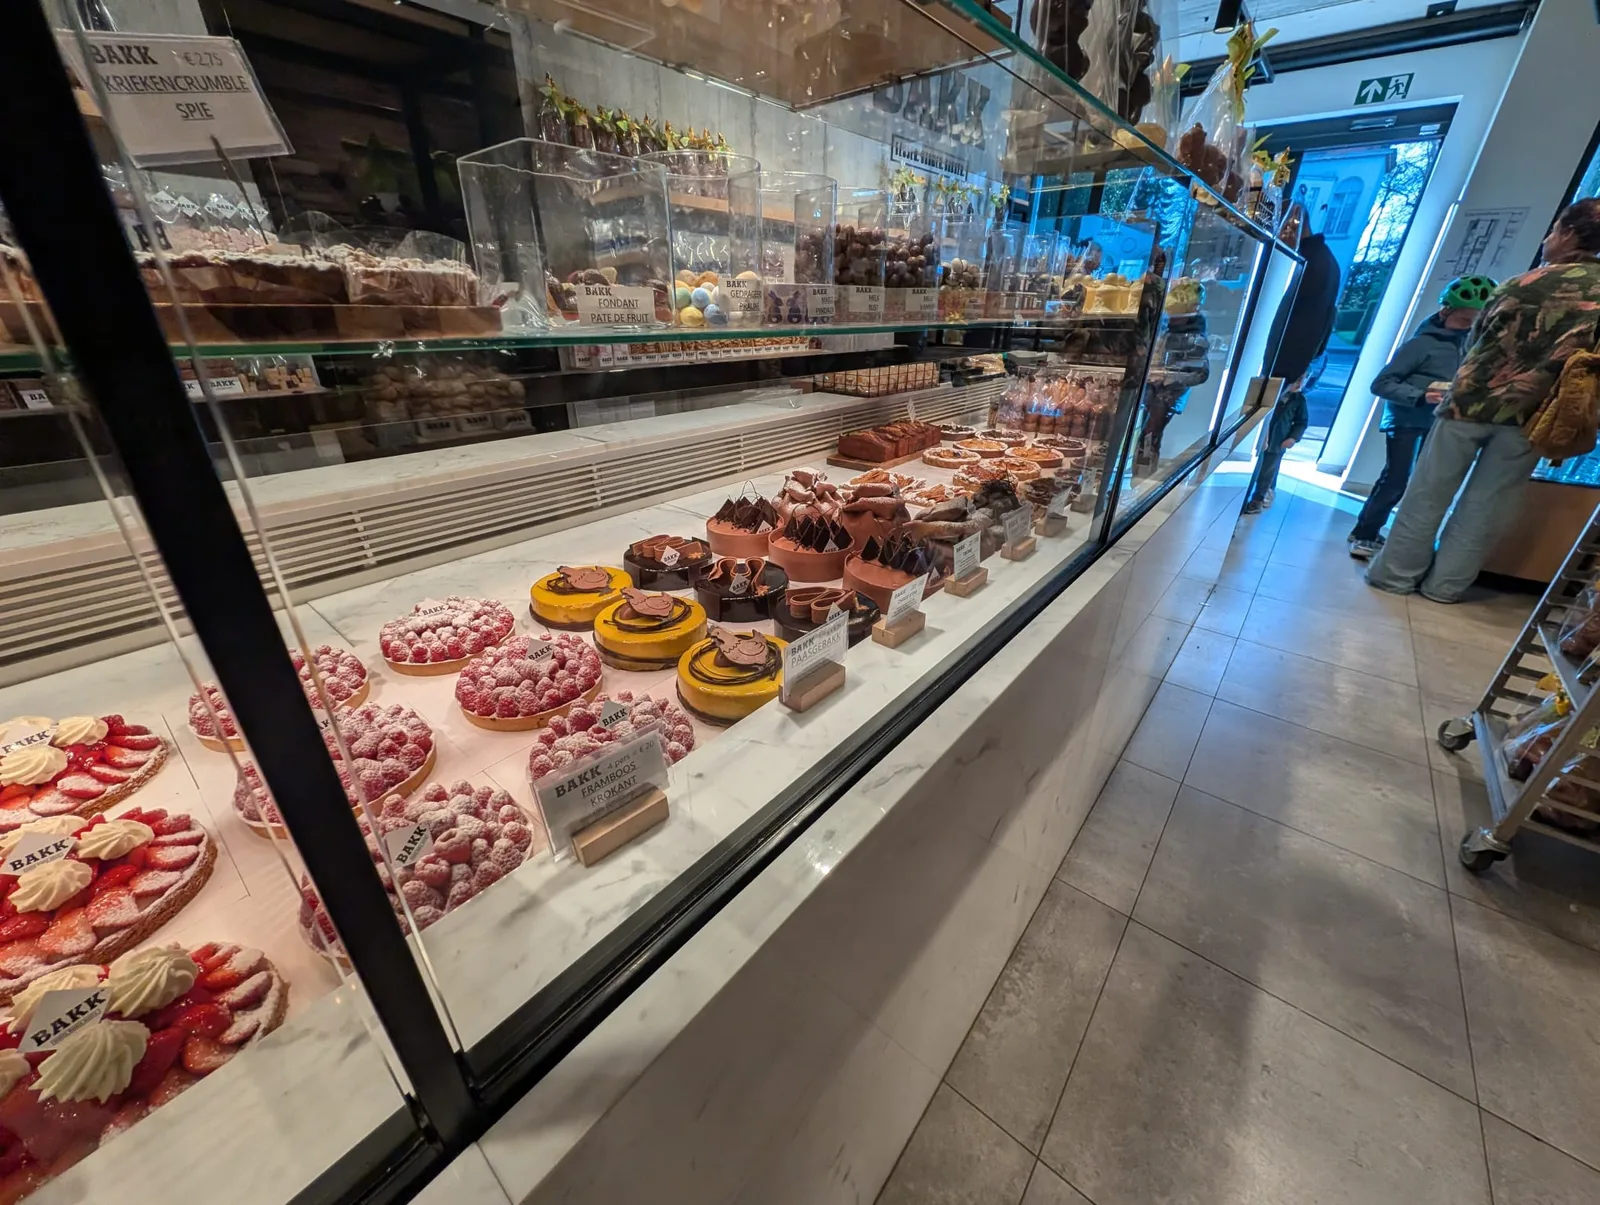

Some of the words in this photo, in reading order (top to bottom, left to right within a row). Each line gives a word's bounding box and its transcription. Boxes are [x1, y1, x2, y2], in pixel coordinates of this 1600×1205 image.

[90, 45, 158, 65] BAKK
[102, 75, 250, 92] KRIEKENCRUMBLE
[175, 102, 214, 119] SPIE
[585, 286, 612, 296] BAKK
[598, 298, 639, 309] FONDANT
[591, 313, 612, 323] PATE
[613, 313, 625, 323] DE
[627, 313, 649, 323] FRUIT
[421, 604, 446, 616] BAKK
[527, 644, 553, 661] BAKK
[791, 636, 816, 657] BAKK
[601, 708, 628, 727] BAKK
[554, 764, 602, 798] BAKK
[580, 761, 637, 798] FRAMBOOS
[590, 775, 638, 807] KROKANT
[395, 825, 427, 864] BAKK
[8, 839, 69, 872] BAKK
[30, 991, 106, 1047] BAKK
